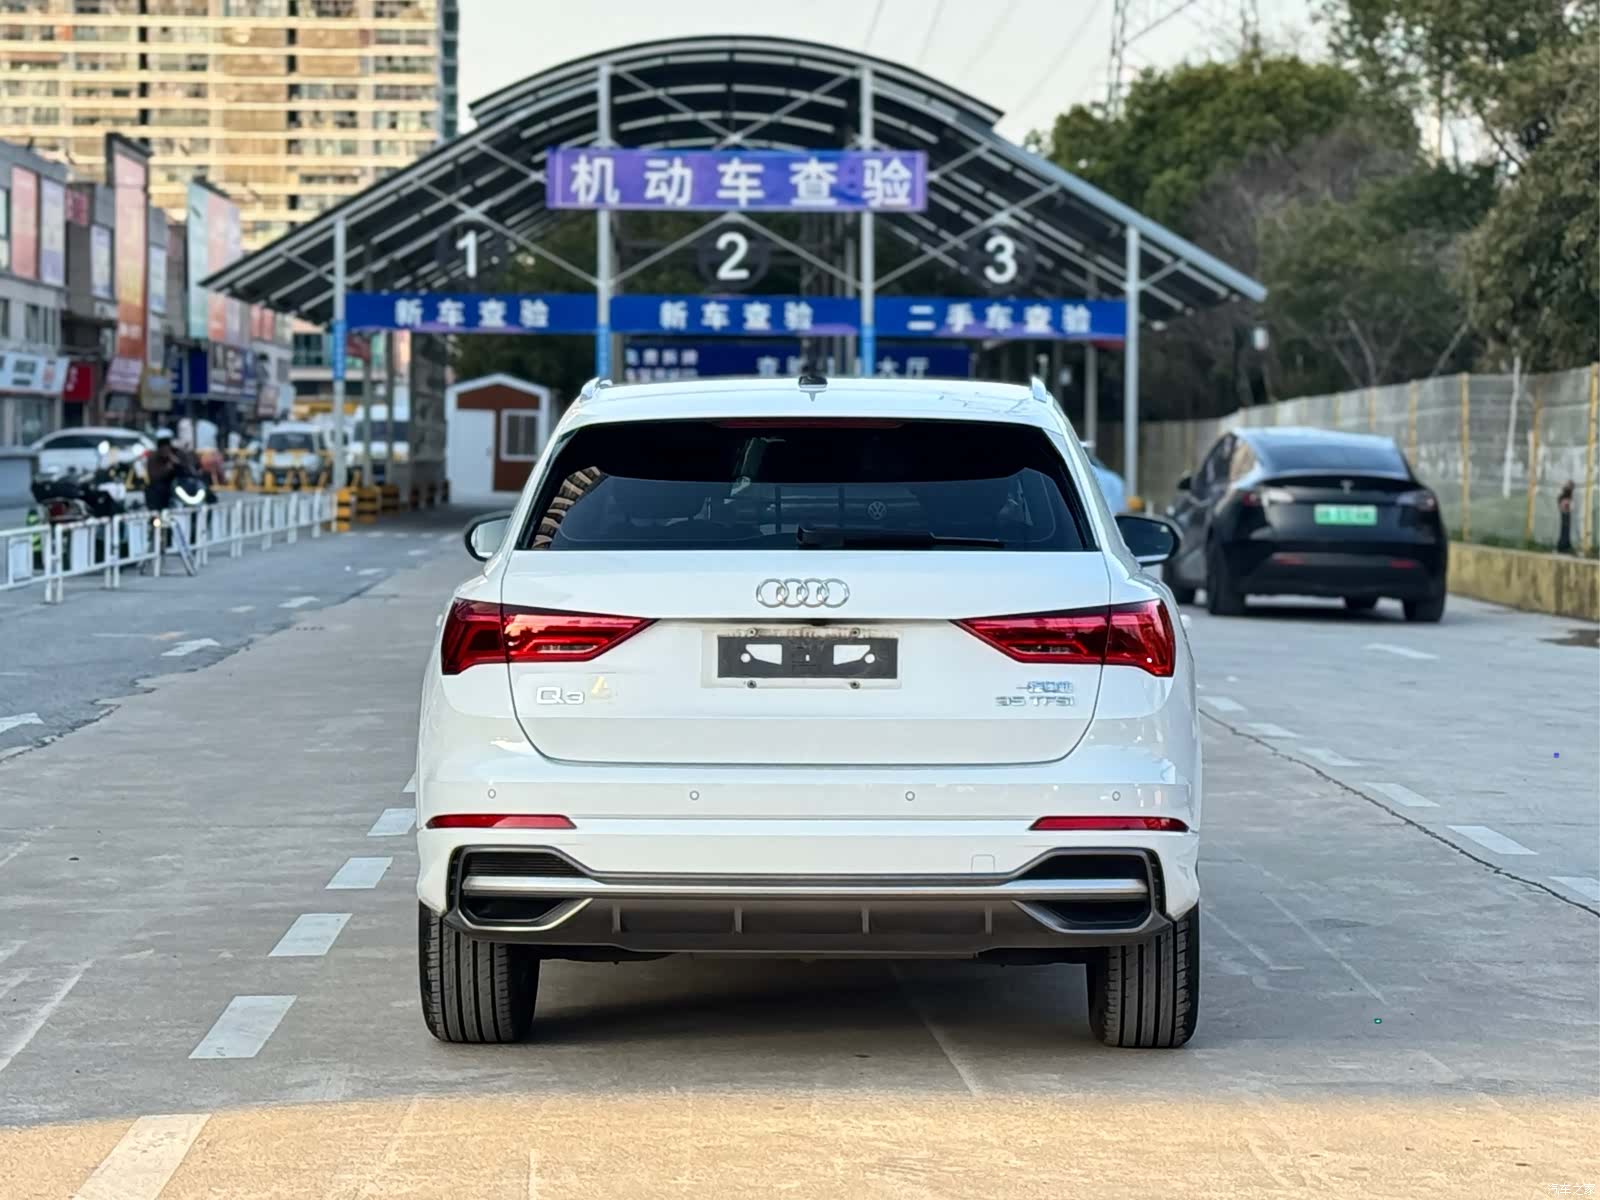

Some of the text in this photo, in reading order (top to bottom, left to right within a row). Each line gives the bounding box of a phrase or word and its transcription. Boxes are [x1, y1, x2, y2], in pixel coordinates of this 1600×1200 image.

[570, 155, 912, 207] 机动车查验
[456, 230, 477, 278] 1
[716, 232, 750, 280] 2
[984, 235, 1018, 284] 3
[394, 298, 549, 327] 新车查验
[659, 301, 813, 331] 新车查验
[907, 303, 1092, 333] 二手车查验
[536, 686, 585, 705] Q3
